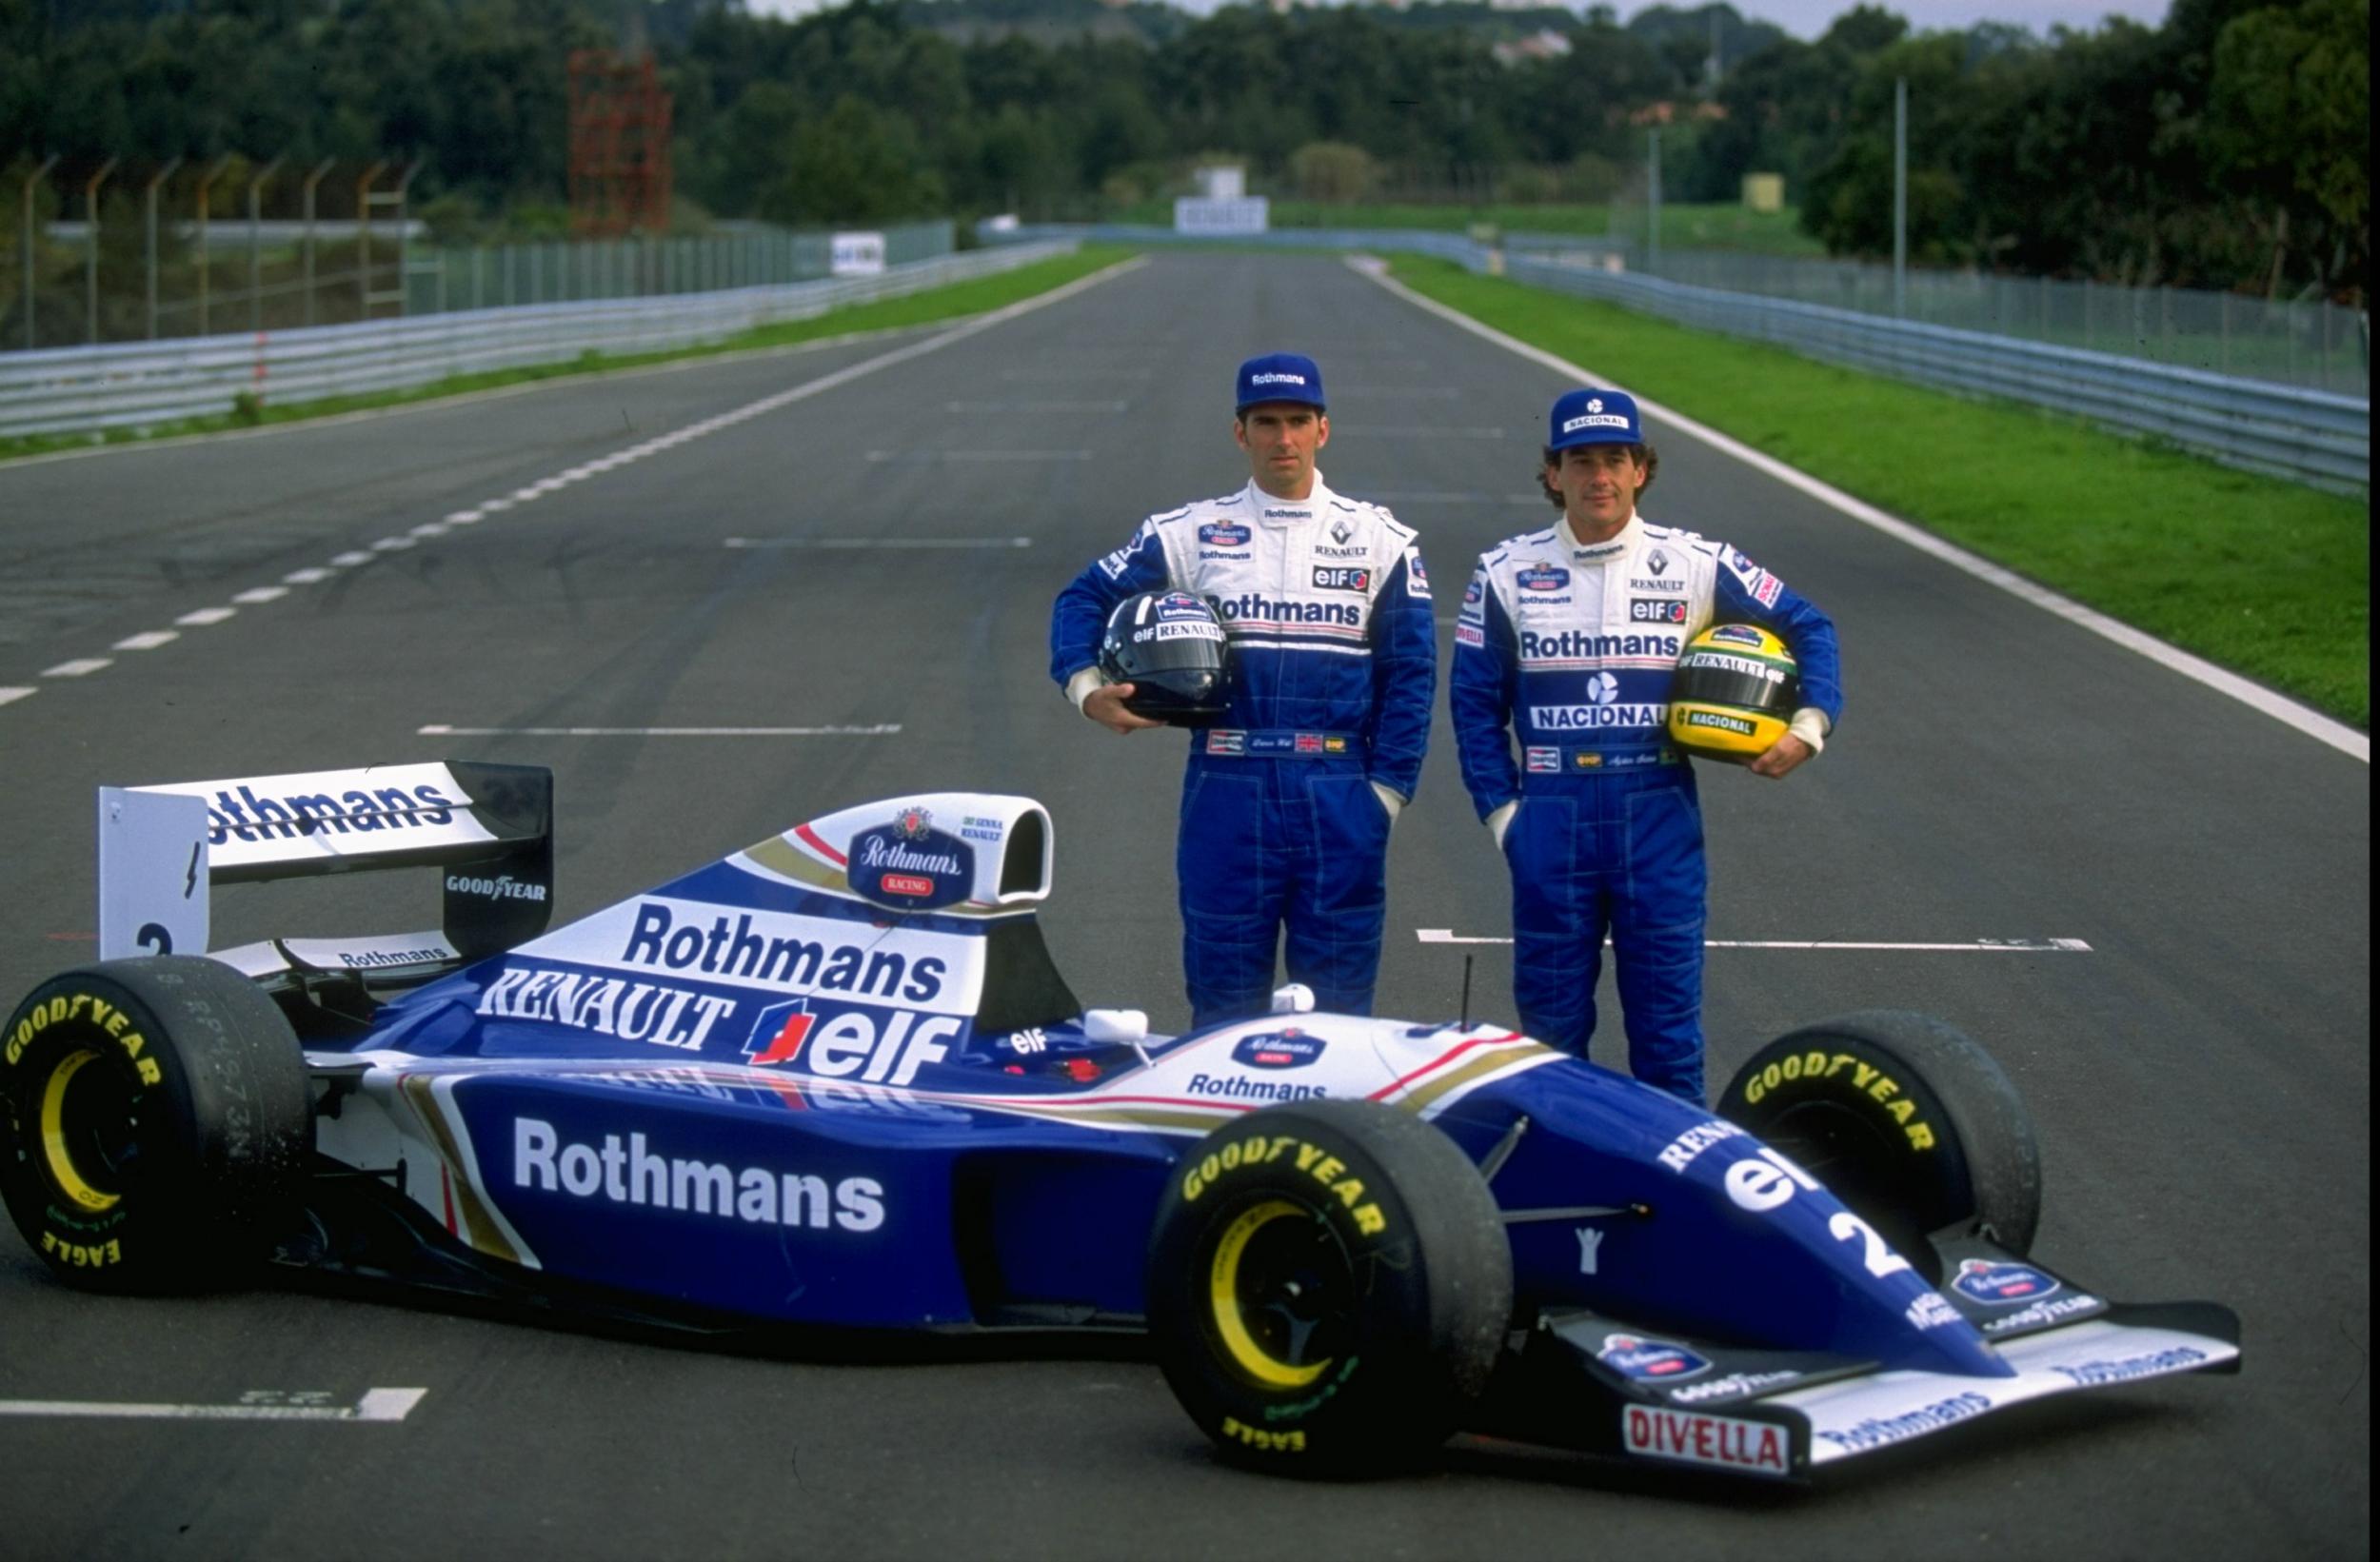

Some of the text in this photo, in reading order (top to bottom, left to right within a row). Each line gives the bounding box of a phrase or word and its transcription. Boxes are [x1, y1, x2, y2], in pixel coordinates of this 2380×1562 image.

[1252, 372, 1305, 386] Rothmans
[1570, 417, 1623, 427] NACIONAL
[1264, 509, 1313, 519] Rothmans
[1200, 550, 1251, 560] Rothmans
[1315, 545, 1368, 556] RENAULT
[1574, 544, 1624, 559] Rothmans
[1315, 569, 1348, 585] elf
[1630, 579, 1685, 590] RENAULT
[1204, 593, 1360, 625] Rothmans
[1633, 603, 1666, 619] elf
[1134, 628, 1154, 643] elf
[1160, 624, 1219, 638] RENAULT
[1521, 630, 1679, 658] Rothmans
[1695, 654, 1761, 678] RENAULT
[1538, 706, 1664, 727] NACIONAL
[1691, 713, 1752, 733] NACIONAL
[208, 784, 453, 845] othmans
[962, 828, 1002, 841] RENAULT
[861, 834, 962, 875] Rothmans
[446, 875, 546, 900] GOODYEAR
[887, 878, 926, 891] RACING
[340, 946, 448, 969] Rothmans
[623, 902, 946, 1002] Rothmans
[476, 967, 736, 1051] RENAULT
[808, 1011, 962, 1086] elf
[1010, 1027, 1046, 1054] elf
[1187, 1074, 1327, 1100] Rothmans
[514, 1117, 885, 1232] Rothmans
[42, 1231, 122, 1268] EAGLE
[1829, 1212, 1912, 1278] 2
[1817, 1391, 1992, 1451] Rothmans
[1223, 1416, 1306, 1451] EAGLE
[1629, 1406, 1783, 1469] DIVELLA
